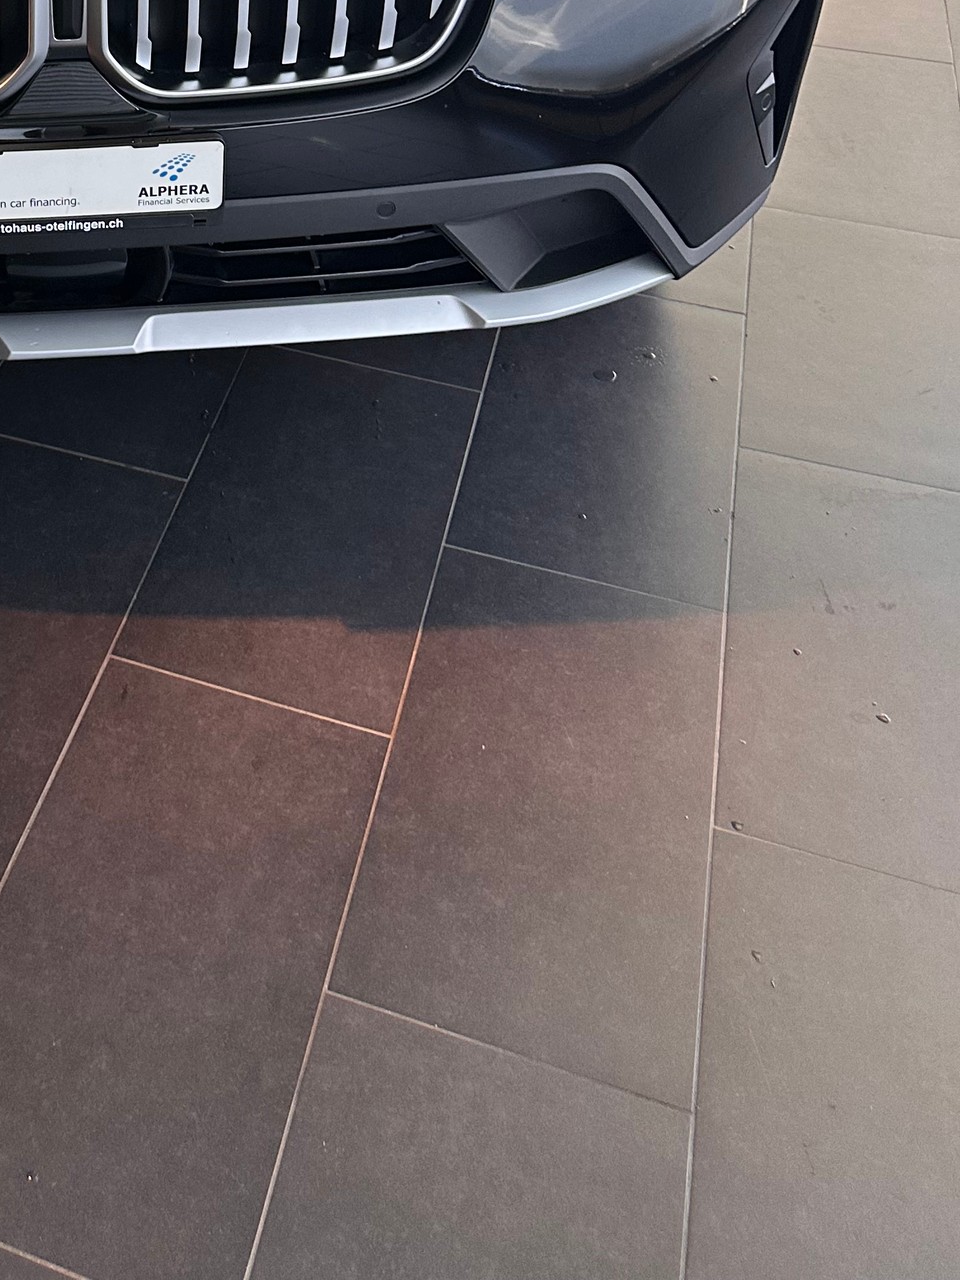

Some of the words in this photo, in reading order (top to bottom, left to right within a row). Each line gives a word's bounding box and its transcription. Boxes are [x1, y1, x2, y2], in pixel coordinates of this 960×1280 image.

[138, 184, 210, 198] ALPHERA
[10, 200, 27, 209] car
[30, 197, 81, 209] financing.
[137, 197, 173, 207] Financial
[176, 196, 210, 205] Services
